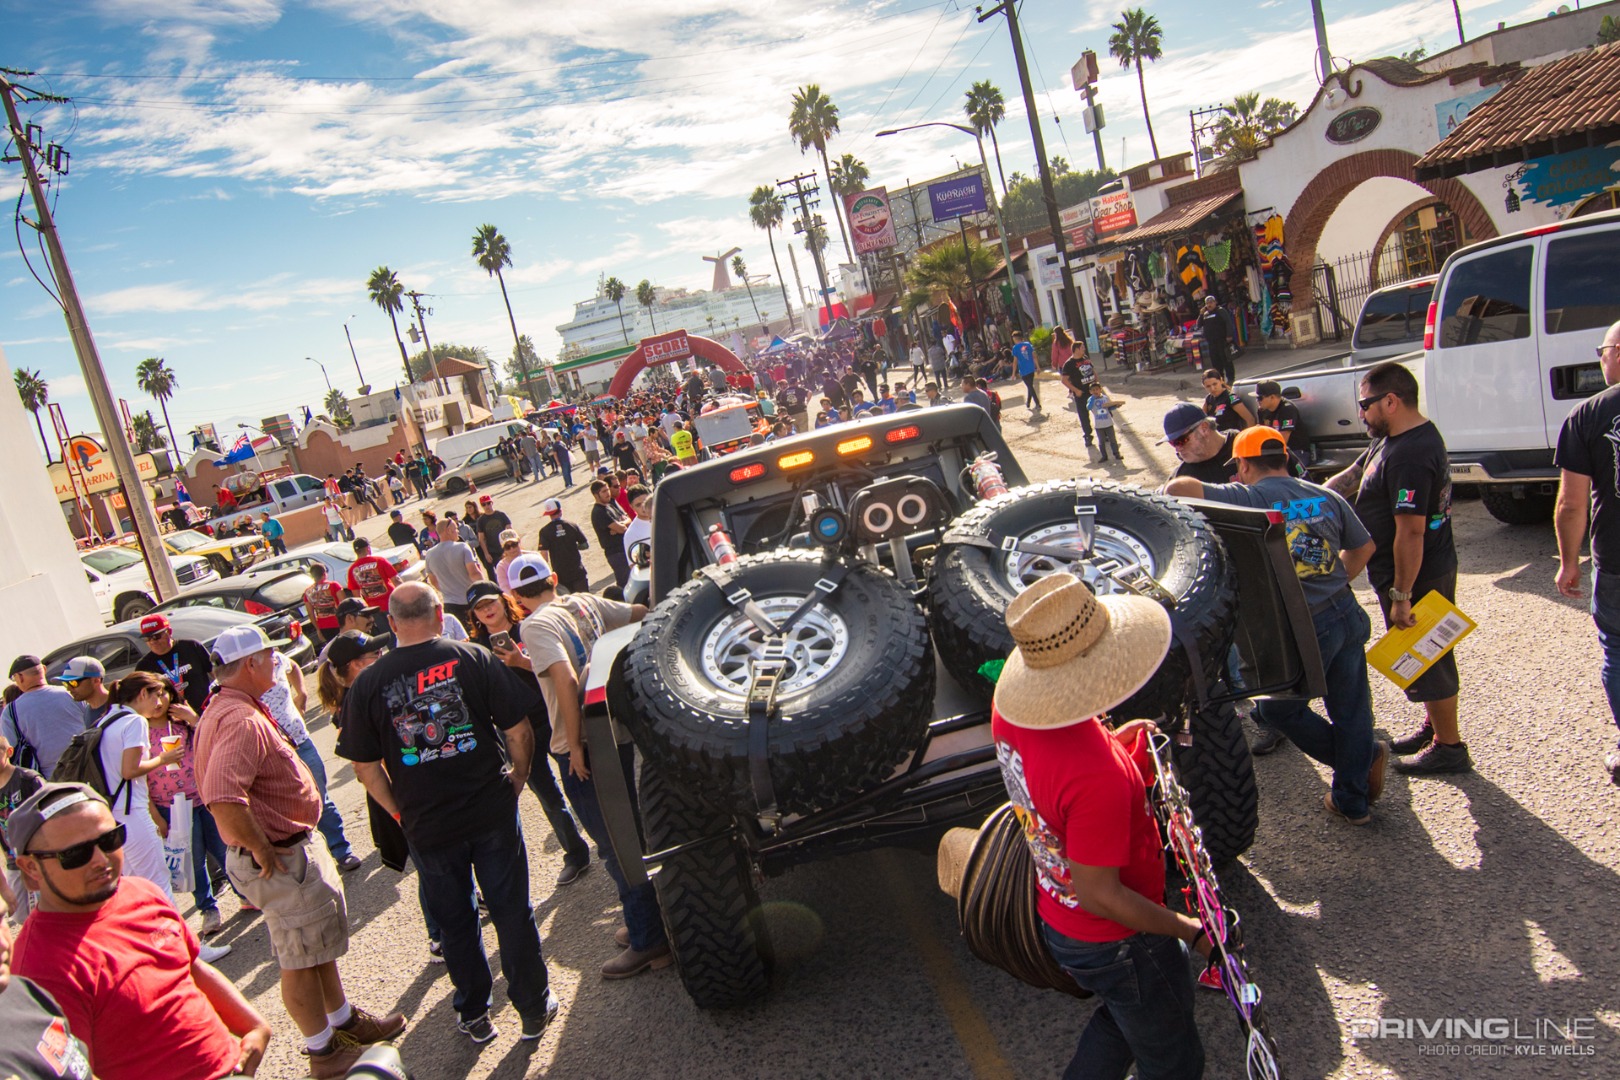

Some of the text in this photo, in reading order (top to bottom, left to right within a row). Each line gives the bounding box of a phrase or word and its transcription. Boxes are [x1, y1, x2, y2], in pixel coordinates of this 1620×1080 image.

[1094, 201, 1132, 219] Cigar Shop
[645, 337, 688, 357] SCORE
[54, 484, 68, 495] LA
[1273, 496, 1327, 520] HRT
[667, 609, 694, 688] COUNTRY
[417, 660, 459, 695] HRT
[455, 731, 475, 740] TOTAL
